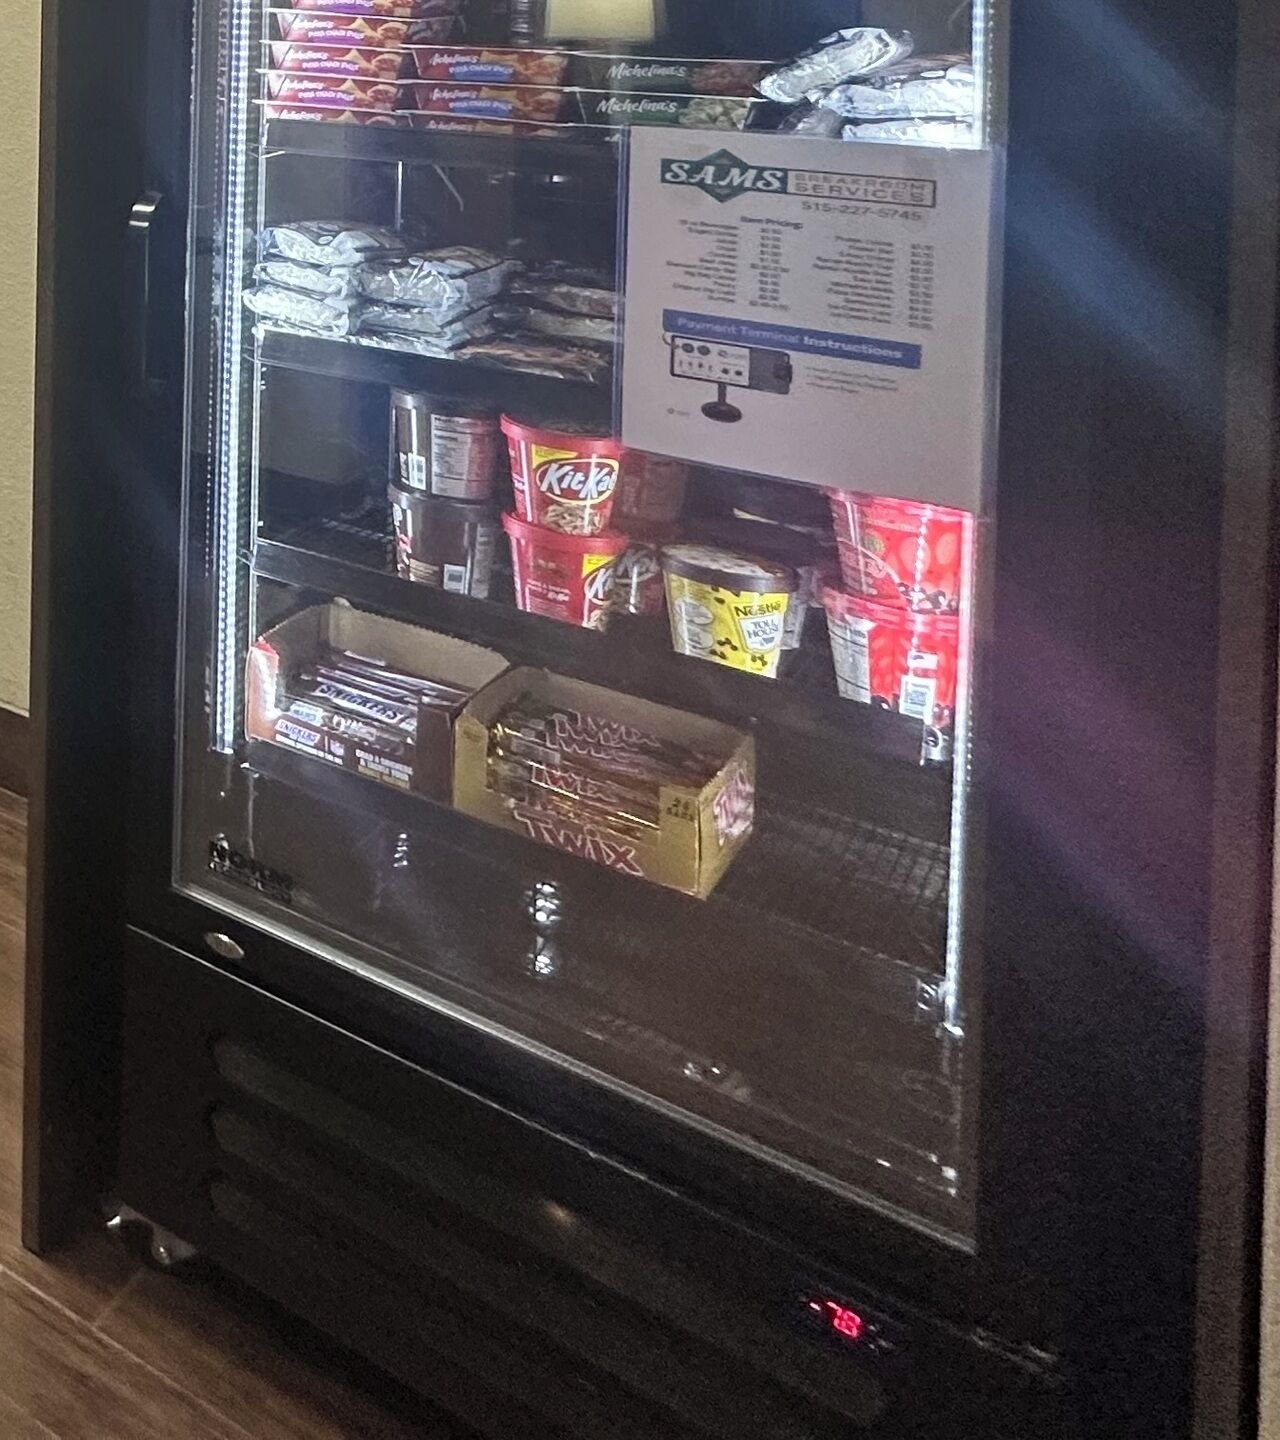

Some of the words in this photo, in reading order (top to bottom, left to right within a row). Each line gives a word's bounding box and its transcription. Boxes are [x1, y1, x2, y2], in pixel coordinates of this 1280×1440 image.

[607, 61, 687, 79] Michelina's
[597, 97, 678, 114] Michelina's
[794, 172, 927, 192] BREAKROOM
[794, 181, 926, 203] SERVICES
[801, 200, 922, 222] 515-227-5745
[677, 316, 739, 336] Payment
[740, 326, 800, 345] Terminal
[803, 335, 904, 359] Instructions
[318, 683, 405, 723] SNICKERS
[278, 721, 320, 743] SNICKERS
